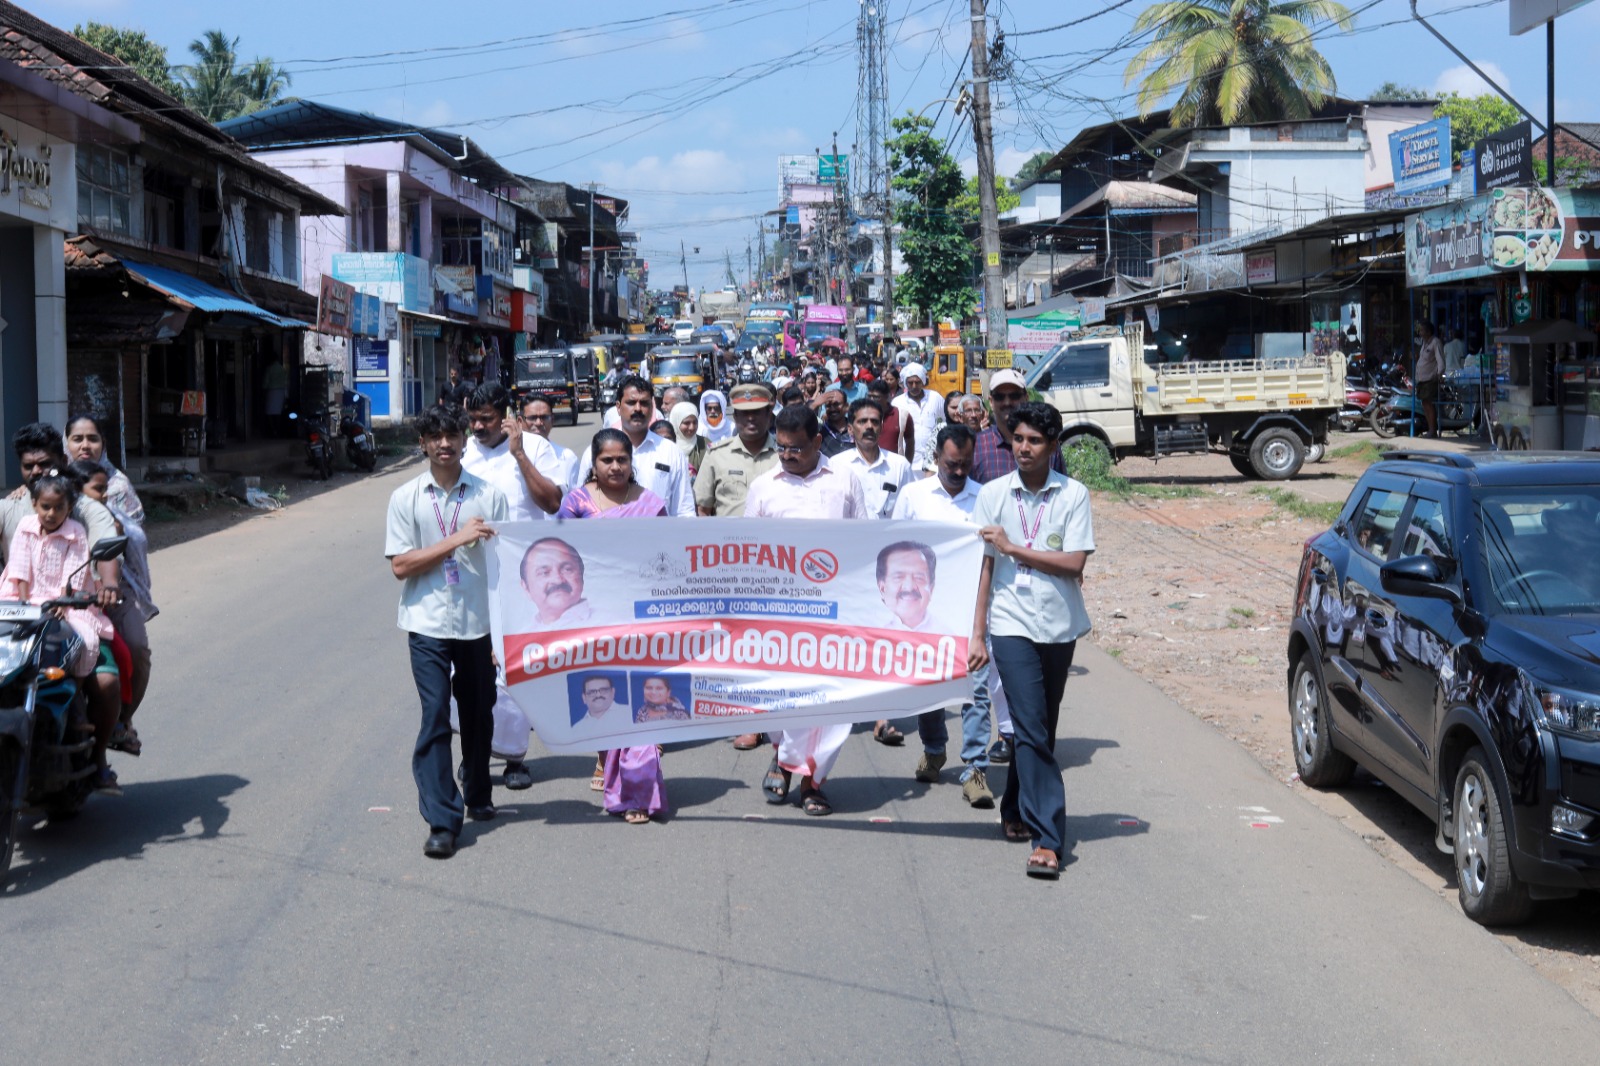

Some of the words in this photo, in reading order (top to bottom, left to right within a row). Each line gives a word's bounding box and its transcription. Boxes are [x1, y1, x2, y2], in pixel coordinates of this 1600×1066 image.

[1411, 136, 1439, 151] TRAVEL
[1411, 149, 1440, 164] SERVICE
[685, 543, 797, 575] TOOFAN
[522, 621, 867, 675] ബോധവൽക്കരണ
[871, 635, 956, 681] റാലി
